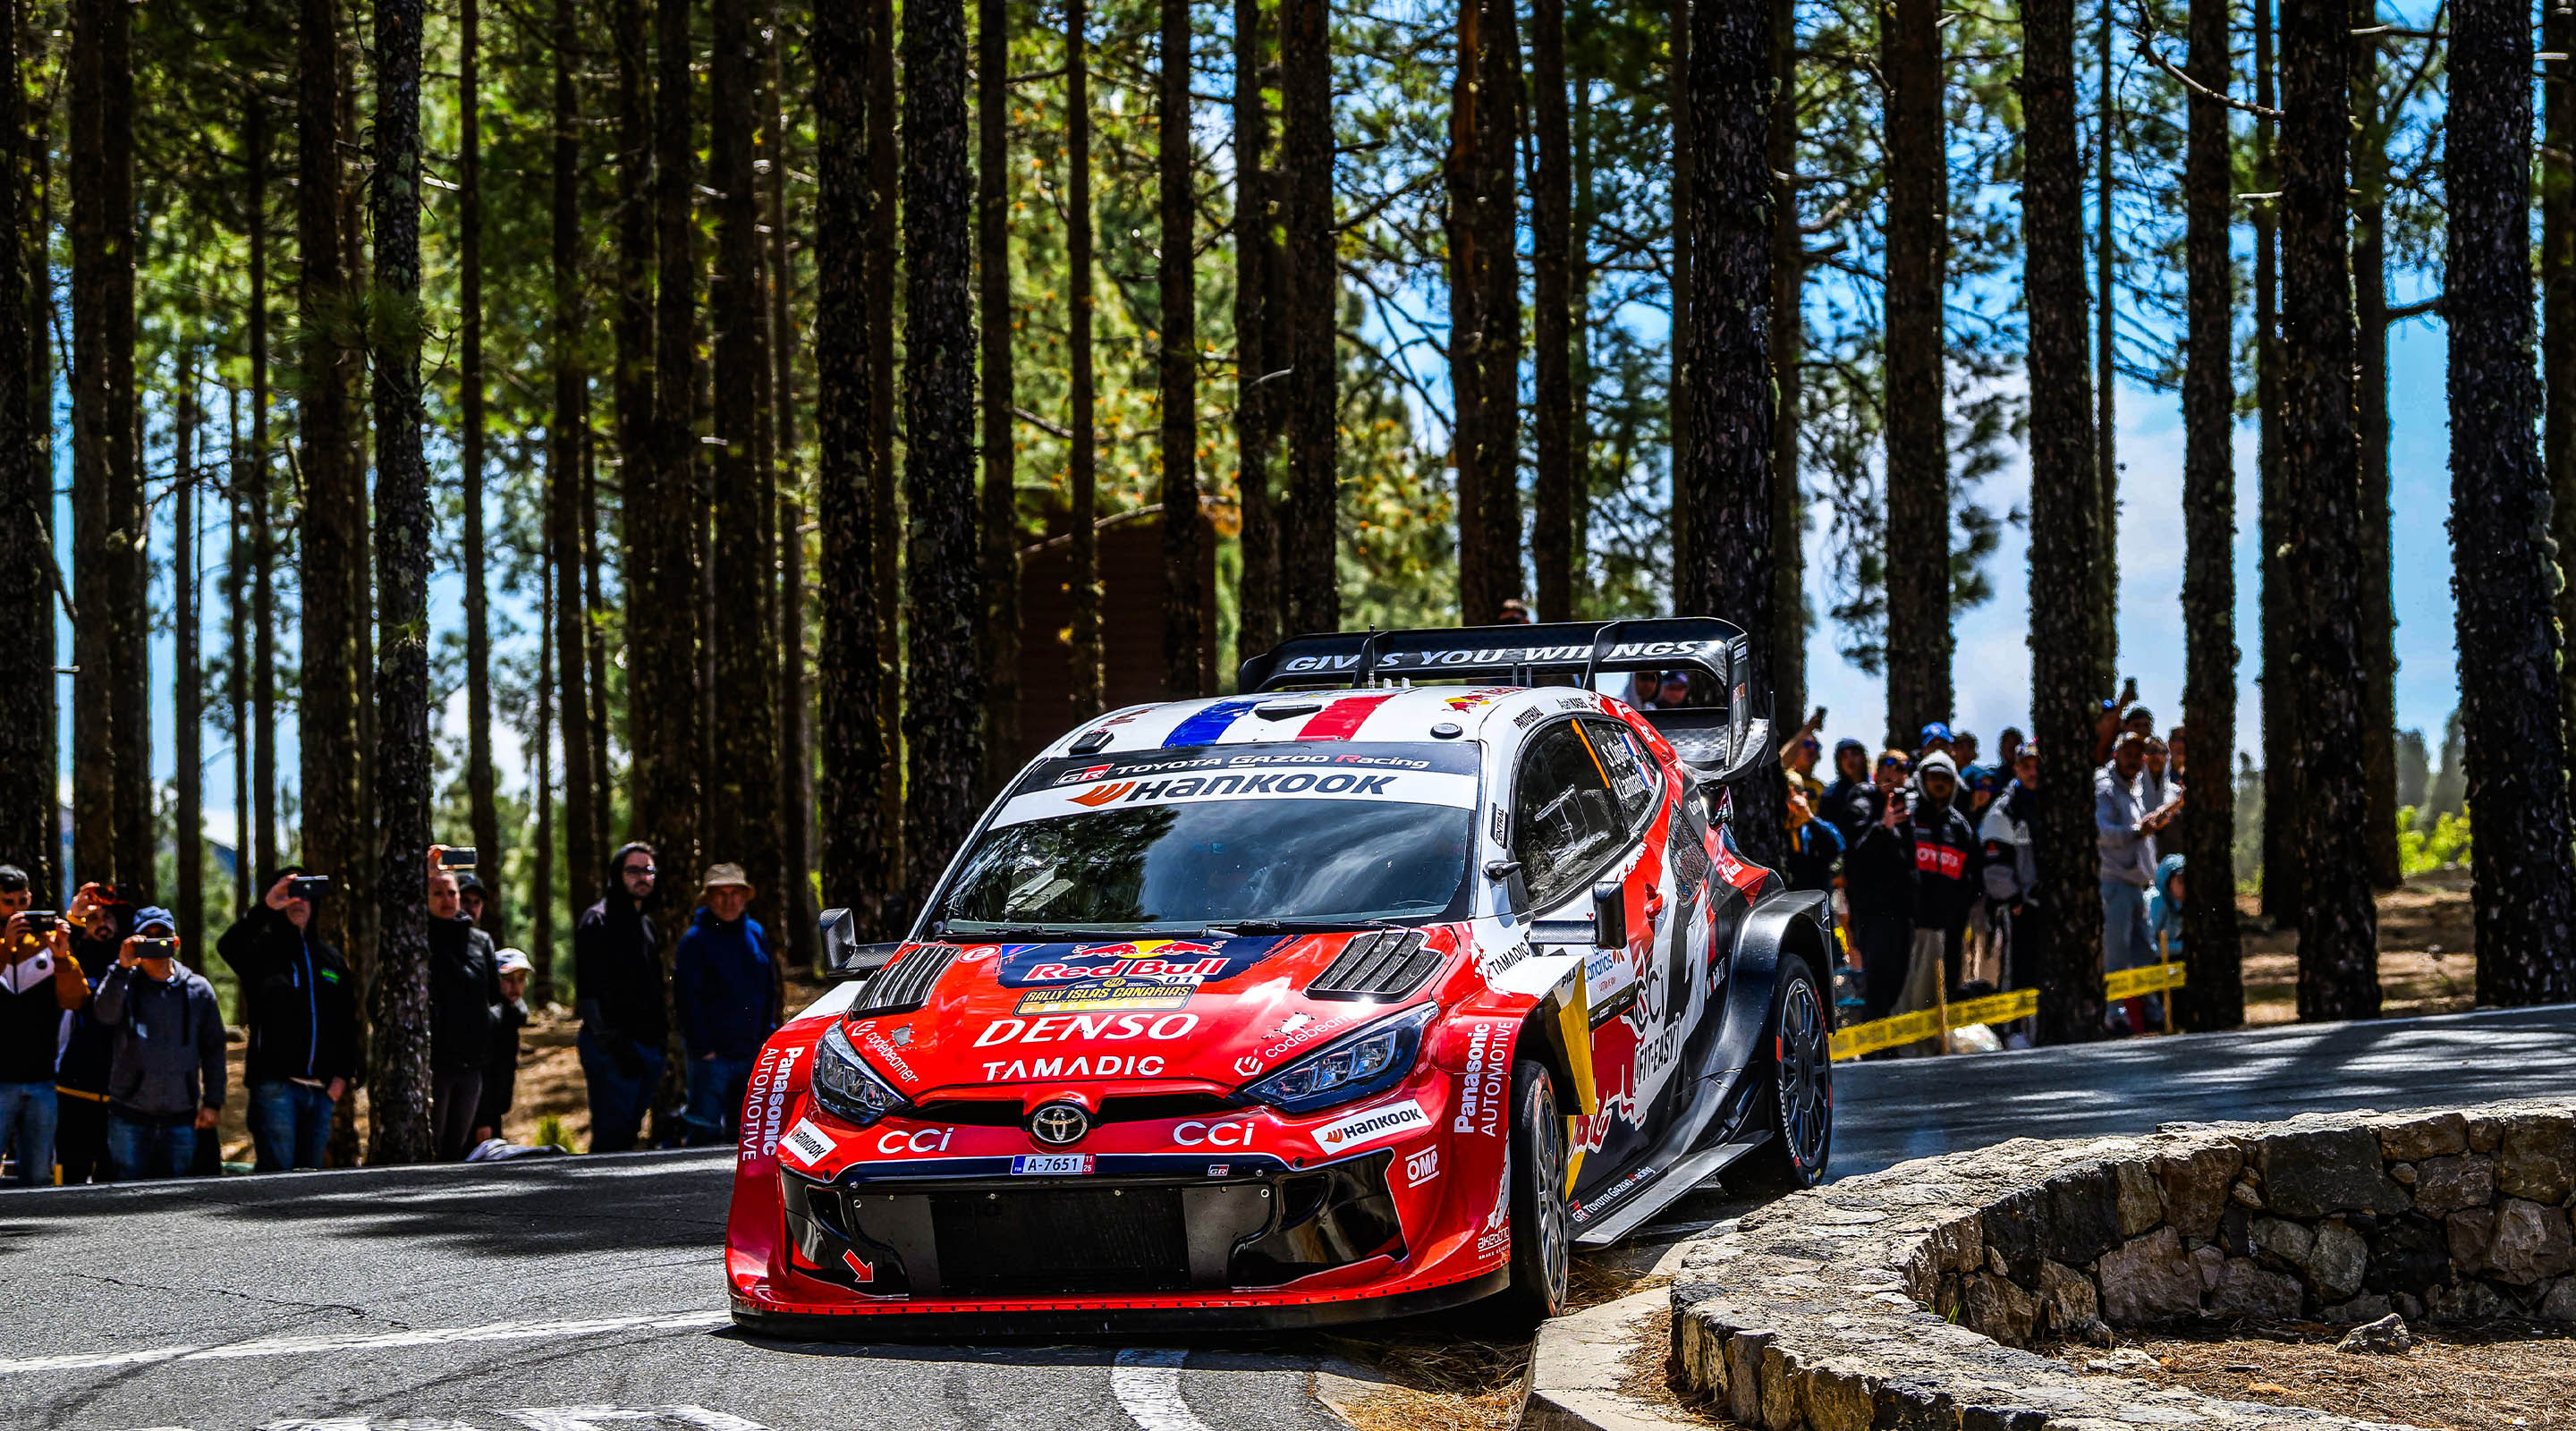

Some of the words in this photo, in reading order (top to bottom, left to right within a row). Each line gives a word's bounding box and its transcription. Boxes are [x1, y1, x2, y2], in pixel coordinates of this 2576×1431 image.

[1285, 652, 1403, 671] GIVS
[1420, 648, 1505, 666] YOU
[1524, 640, 1700, 661] WIINGS
[1115, 757, 1223, 775] TOYOTA
[1229, 754, 1330, 766] GAZOO
[1334, 754, 1432, 769] Racing
[1495, 809, 1505, 846] CENTRAL
[1022, 959, 1129, 981] Red
[1127, 958, 1232, 977] Bull
[1489, 941, 1530, 976] TAMADIC
[1025, 989, 1067, 1002] RALLY
[1066, 986, 1109, 999] ISLAS
[1111, 985, 1191, 997] CANARIAS
[1561, 967, 1577, 987] PIAA
[973, 1012, 1200, 1049] DENSO
[866, 1032, 919, 1082] codebeamer
[982, 1055, 1165, 1081] TAMADIC
[1453, 1023, 1491, 1133] Panasonic
[1480, 1021, 1513, 1138] AUTOMOTIVE
[742, 1047, 780, 1161] AUTOMOTIVE
[763, 1046, 805, 1156] Panasonic
[1027, 1157, 1078, 1172] A-7651
[1407, 1150, 1438, 1181] OMP
[1586, 1191, 1614, 1215] TOYOTA
[1607, 1178, 1634, 1198] GAZOO
